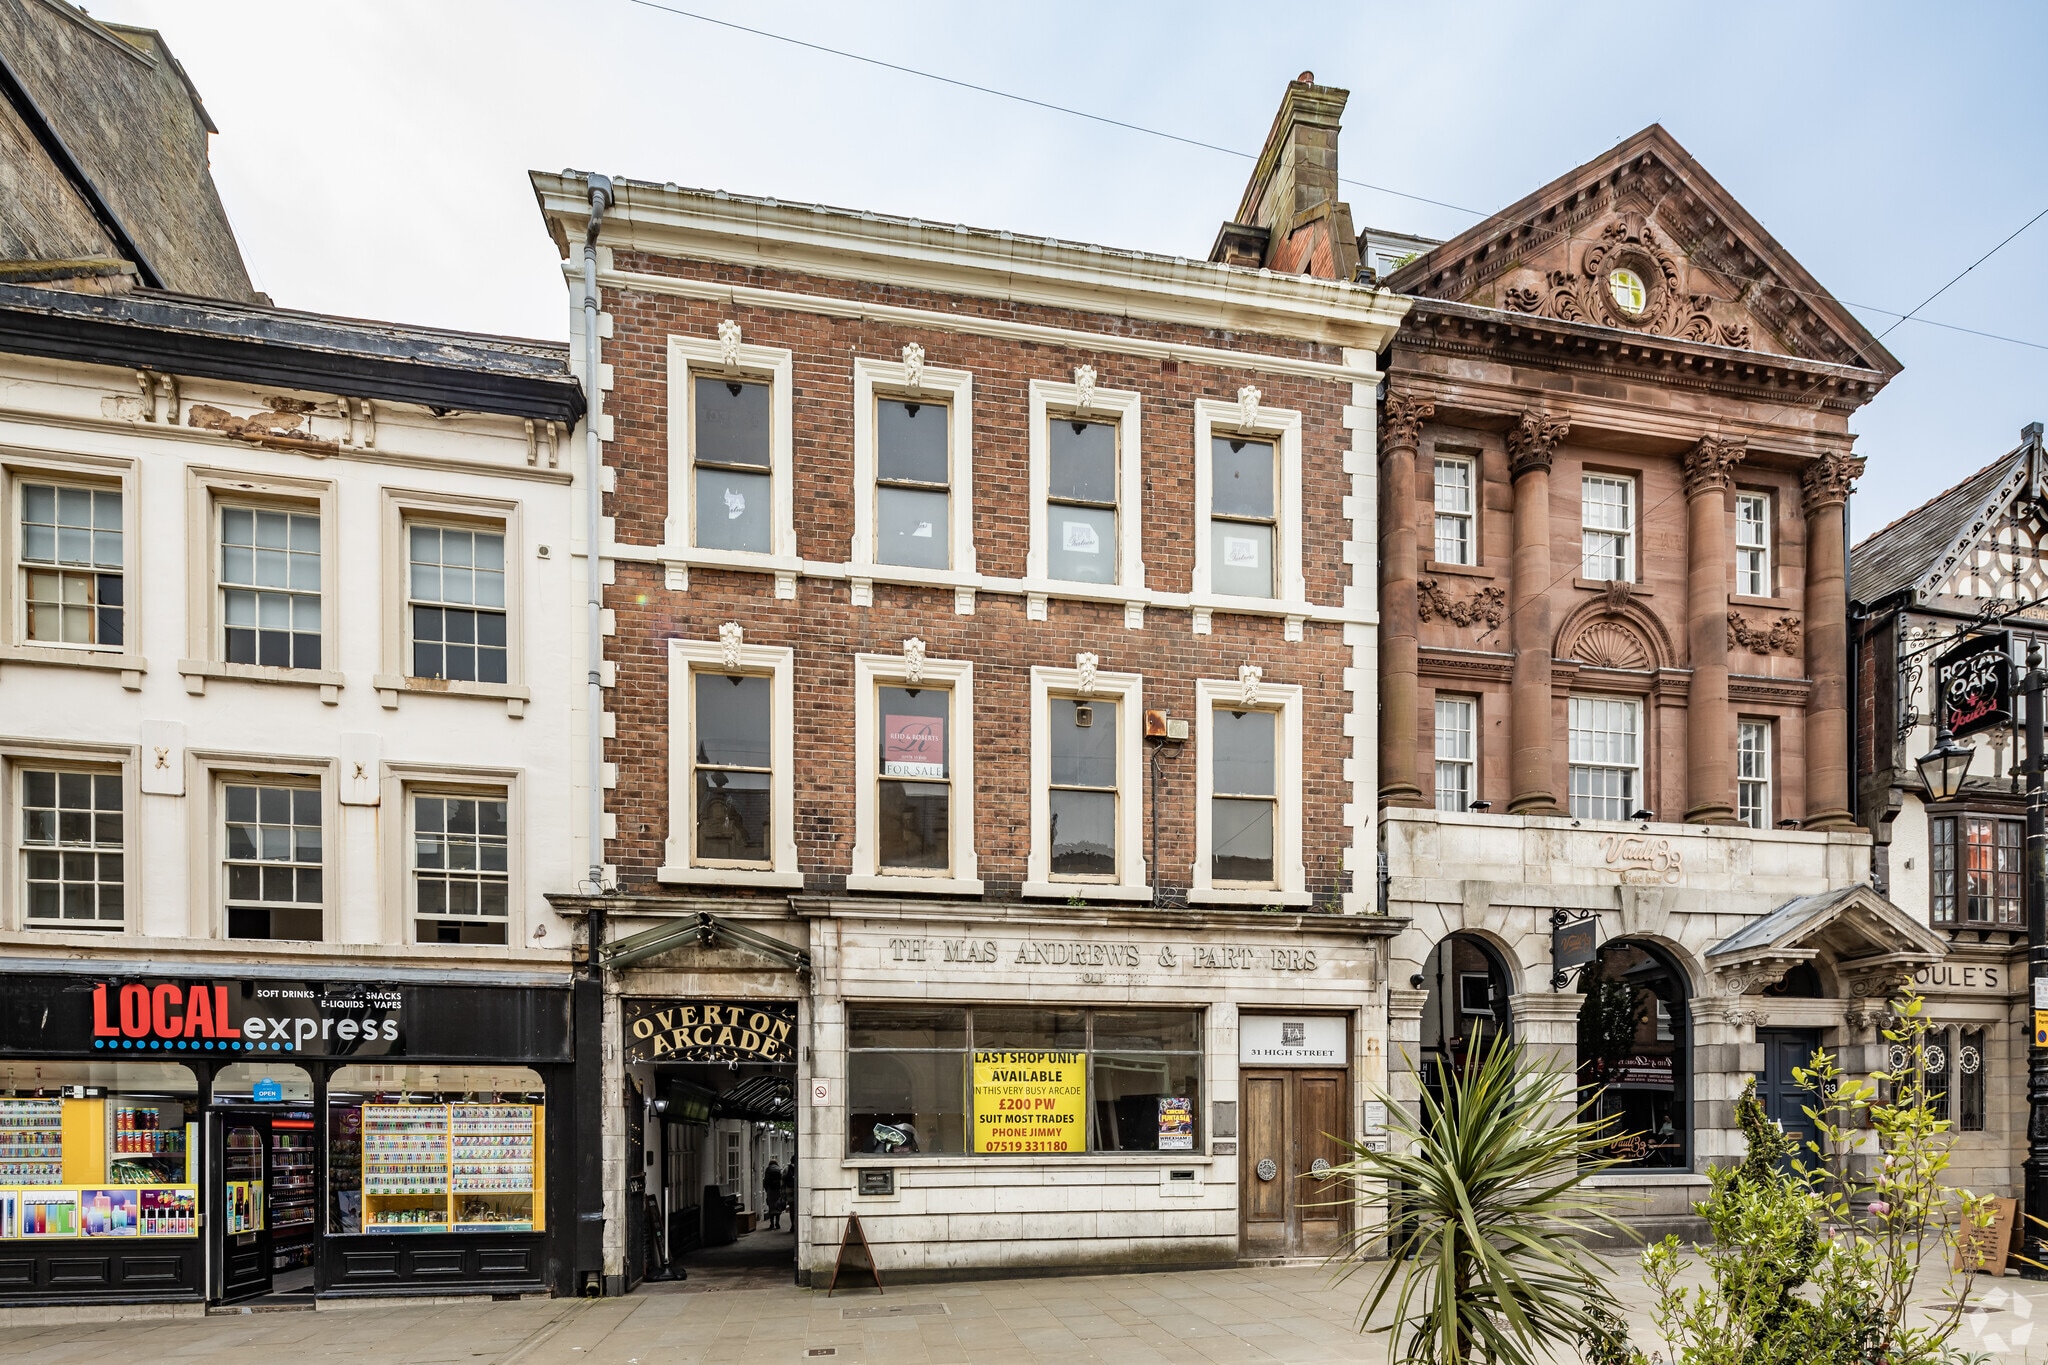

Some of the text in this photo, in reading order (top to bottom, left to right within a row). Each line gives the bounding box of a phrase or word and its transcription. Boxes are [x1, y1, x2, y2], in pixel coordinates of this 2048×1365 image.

[1951, 665, 1996, 695] OAK
[912, 734, 939, 742] ROBERTS
[887, 765, 941, 776] FOR SALE
[1014, 941, 1140, 967] ANDREWS
[1158, 945, 1177, 967] &
[1914, 966, 1998, 987] OULE'S
[257, 989, 279, 998] SOFT
[282, 990, 314, 998] DRINKS
[365, 992, 402, 1000] SNACKS
[321, 1000, 364, 1008] E-LIQUIDS
[374, 1001, 402, 1009] VAPES
[92, 983, 240, 1038] LOCAL
[632, 1005, 792, 1042] OVERTON
[243, 1016, 399, 1051] express
[653, 1025, 780, 1060] ARCADE
[975, 1052, 1079, 1064] LAST SHOP UNIT
[1296, 1049, 1335, 1057] STREET
[992, 1071, 1062, 1082] AVAILABLE
[974, 1086, 1081, 1095] N THIS VERY BUSY ARCADE
[1824, 1083, 1836, 1093] 33
[999, 1098, 1056, 1110] £200 PW
[980, 1114, 1074, 1124] SUIT MOST TRADES
[1161, 1114, 1190, 1122] FUNTASIA
[992, 1128, 1062, 1137] PHONE JIMMY
[986, 1141, 1068, 1152] 07519 331180
